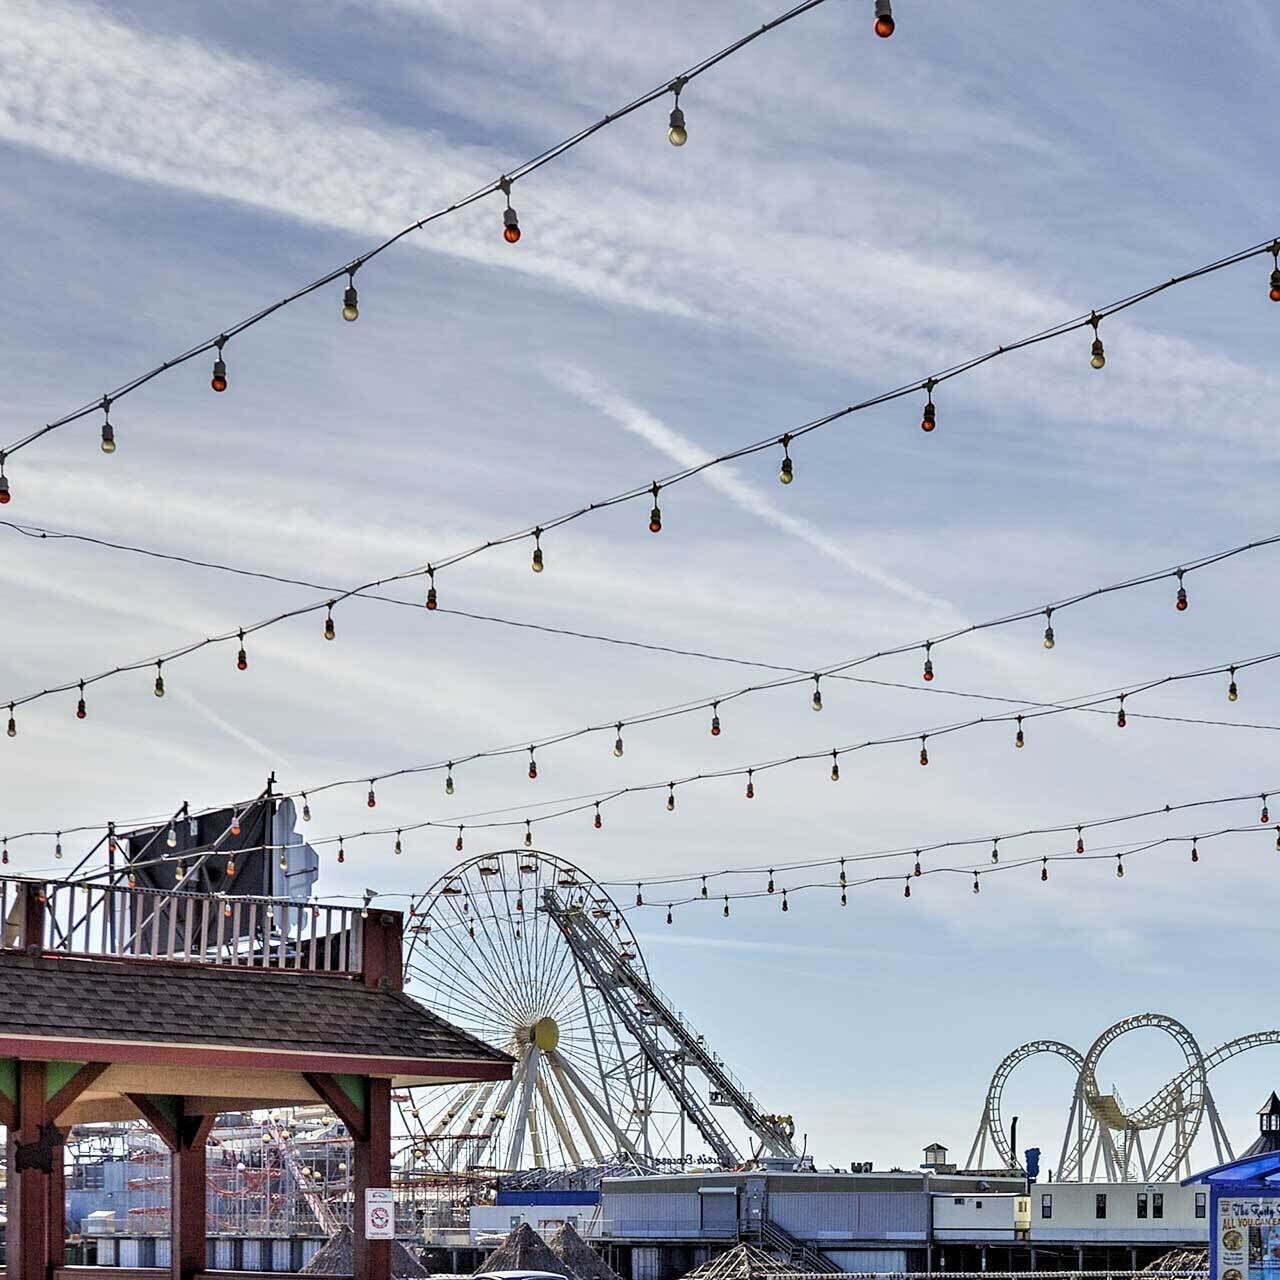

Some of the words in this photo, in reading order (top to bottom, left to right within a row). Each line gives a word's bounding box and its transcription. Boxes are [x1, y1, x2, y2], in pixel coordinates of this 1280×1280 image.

[1232, 1203, 1249, 1216] The
[1222, 1219, 1236, 1231] ALL
[1238, 1218, 1252, 1227] YOU
[1255, 1218, 1270, 1226] CAN
